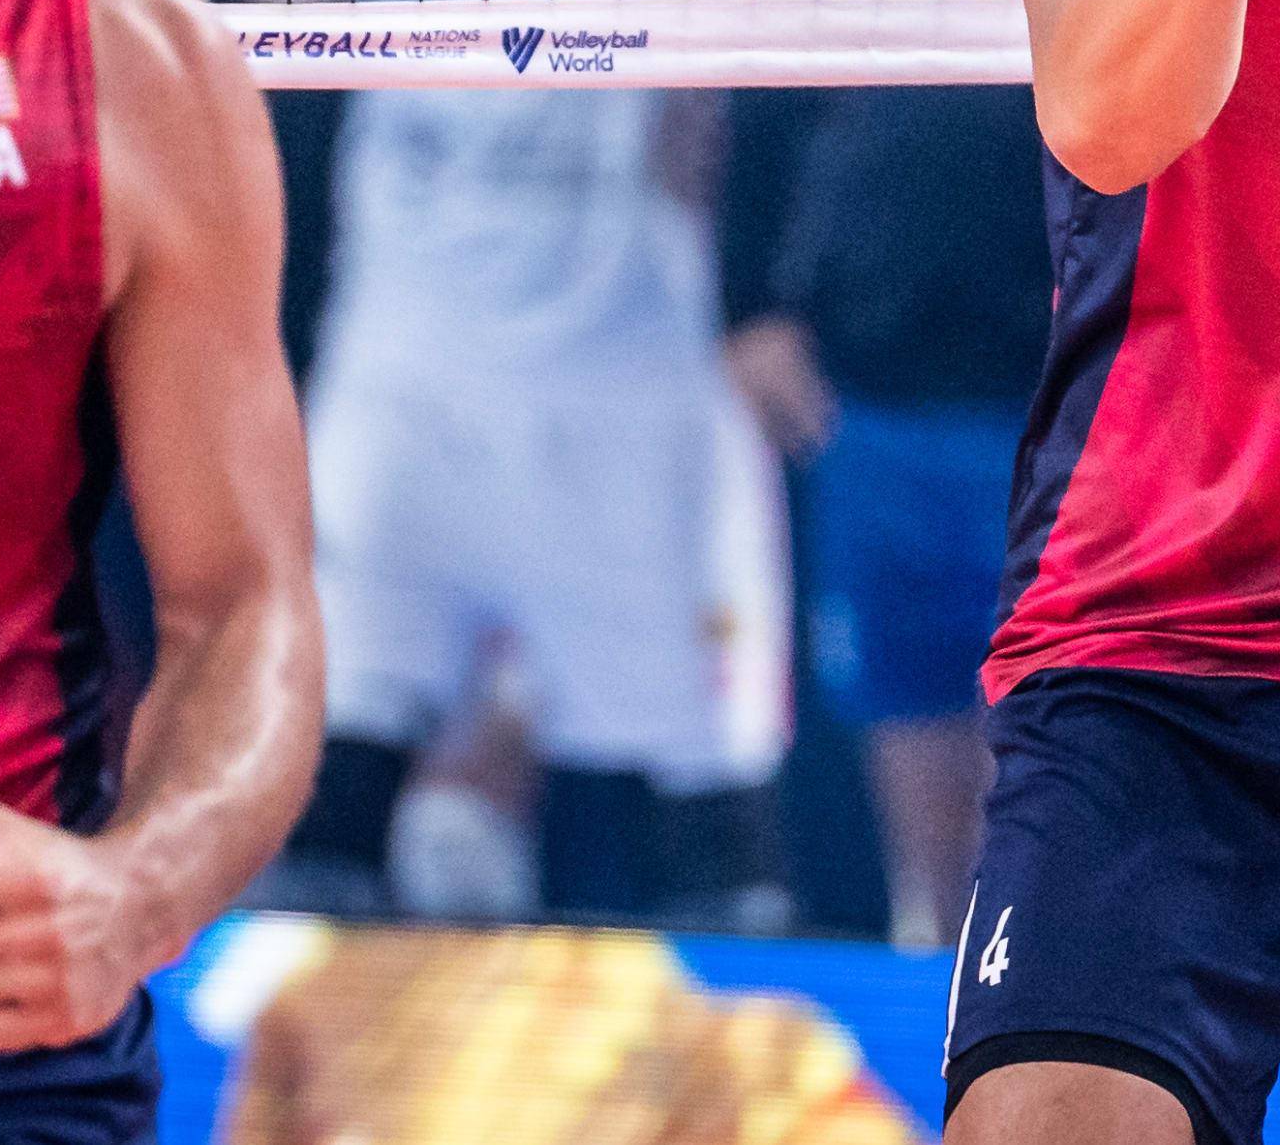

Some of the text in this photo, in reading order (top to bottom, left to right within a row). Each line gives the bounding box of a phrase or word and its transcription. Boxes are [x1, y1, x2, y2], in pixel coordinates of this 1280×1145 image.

[408, 29, 481, 43] NATIONS
[550, 29, 649, 53] Volleyball
[404, 45, 467, 59] LEAGUE
[547, 52, 615, 73] World
[978, 905, 1014, 987] 4
